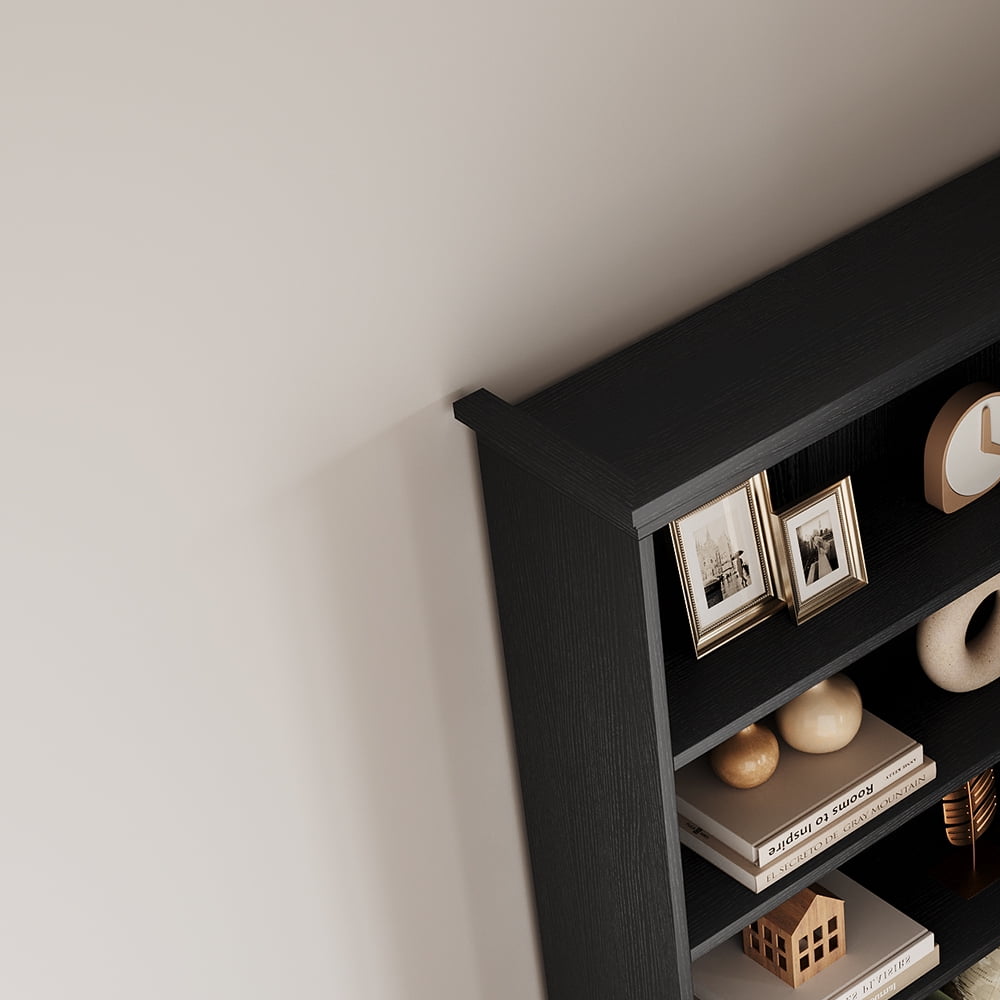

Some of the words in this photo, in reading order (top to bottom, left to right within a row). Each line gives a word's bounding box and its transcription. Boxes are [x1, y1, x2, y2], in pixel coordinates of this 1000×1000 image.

[832, 783, 874, 816] Rooms
[765, 871, 778, 883] EL
[777, 842, 823, 875] SECRETO
[824, 832, 839, 845] DE
[843, 813, 870, 832] GRAY
[870, 774, 926, 815] MOUNTAIN
[815, 812, 829, 827] to
[768, 824, 812, 857] Inspire
